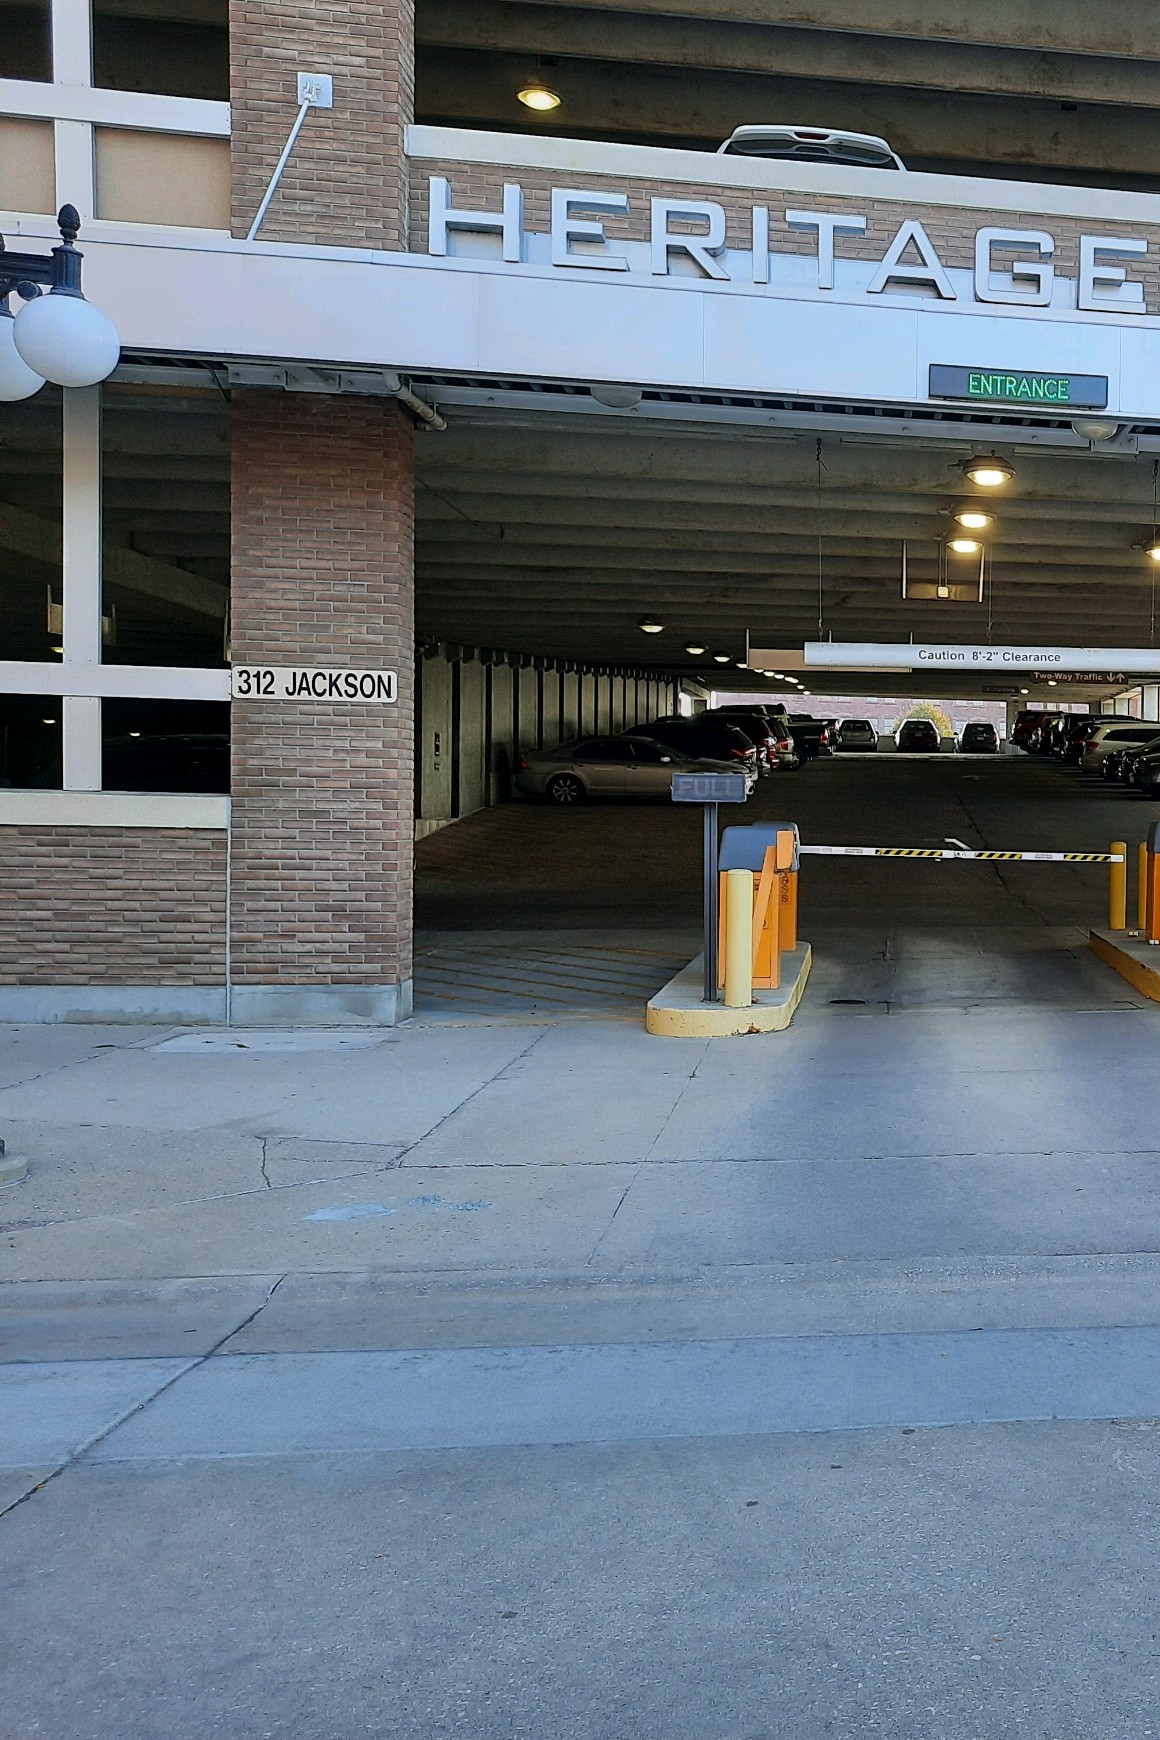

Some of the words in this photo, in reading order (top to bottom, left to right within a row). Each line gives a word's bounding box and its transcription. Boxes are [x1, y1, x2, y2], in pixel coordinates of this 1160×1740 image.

[428, 175, 1148, 315] HERITAGE
[968, 373, 1070, 400] ENTRANCE
[918, 649, 966, 661] Caution
[971, 650, 999, 662] 8'-2"
[1002, 651, 1062, 663] Clearance
[237, 669, 276, 695] 312
[285, 671, 392, 699] JACKSON
[1033, 671, 1073, 682] Two-Way
[1075, 672, 1103, 681] Traffic
[681, 779, 739, 797] FULL
